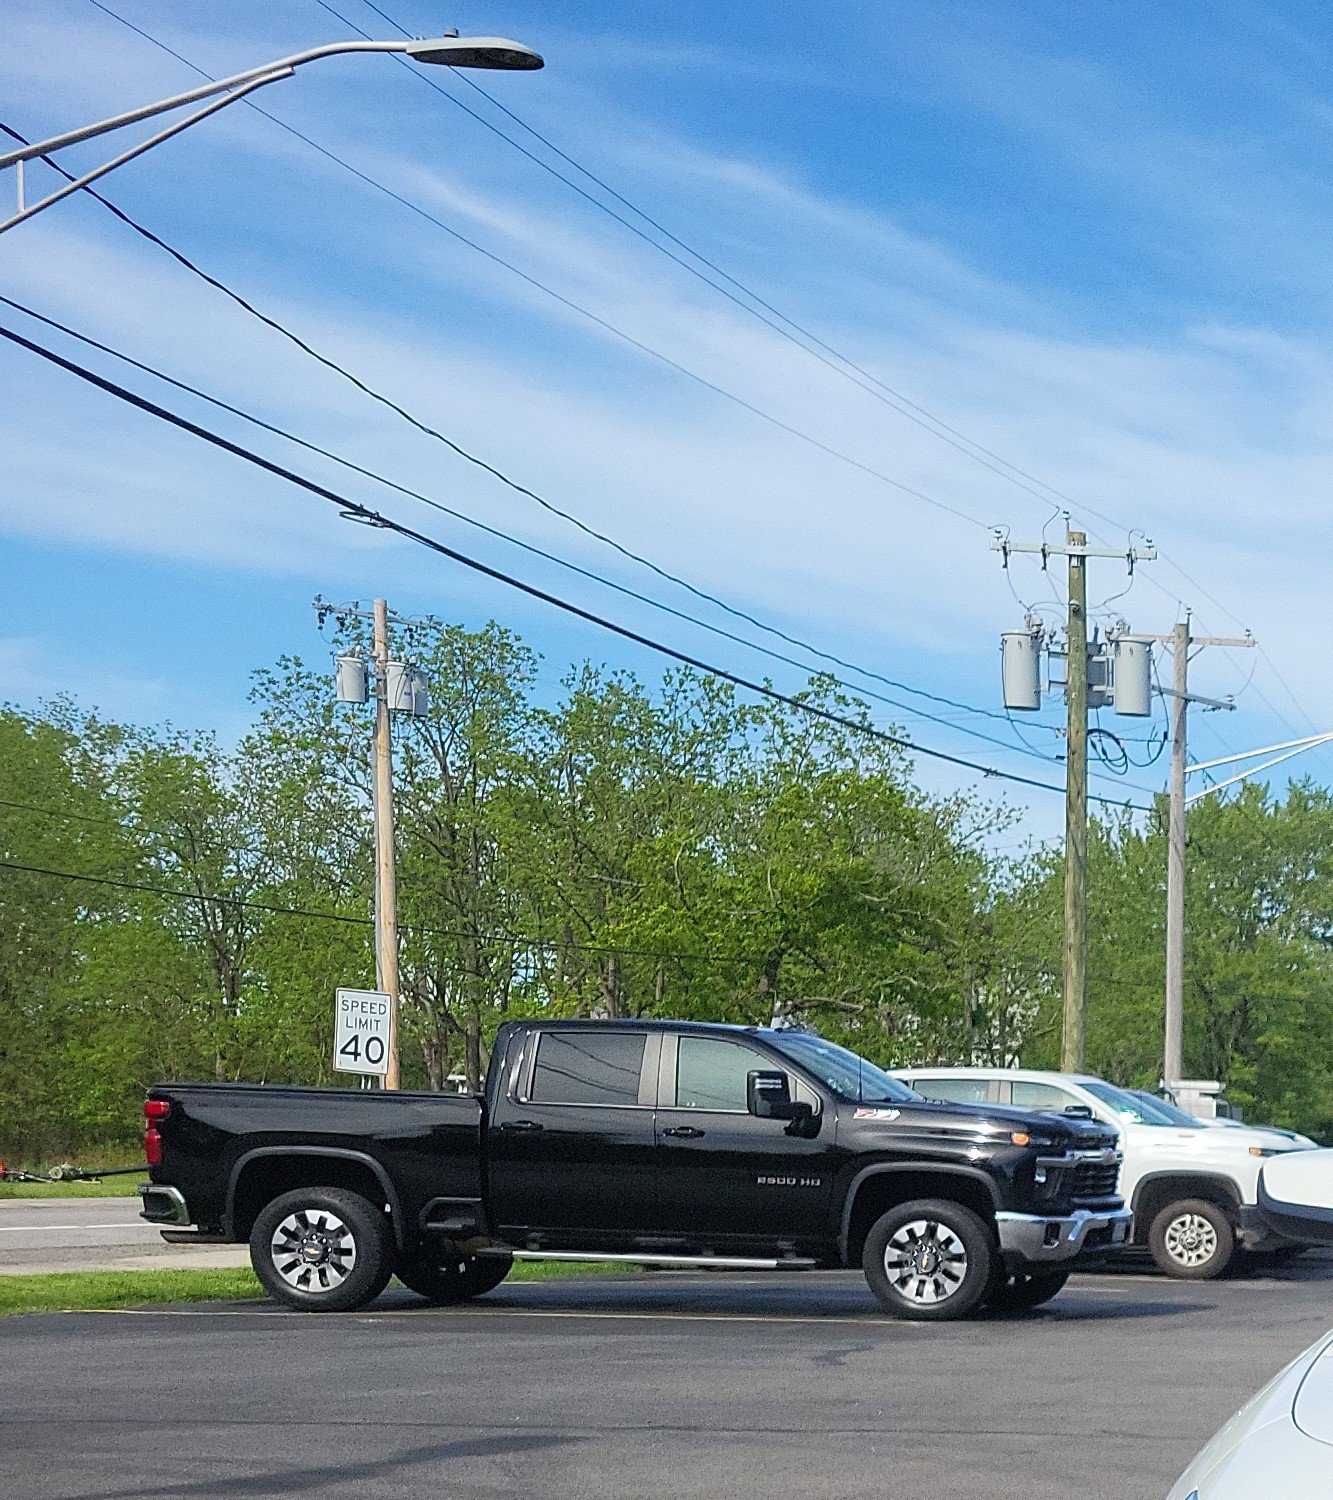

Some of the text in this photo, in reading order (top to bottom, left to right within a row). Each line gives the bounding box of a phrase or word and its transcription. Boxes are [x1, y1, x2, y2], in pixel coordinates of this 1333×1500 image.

[342, 1000, 386, 1015] SPEED
[346, 1017, 380, 1031] LIMIT
[340, 1034, 384, 1064] 40
